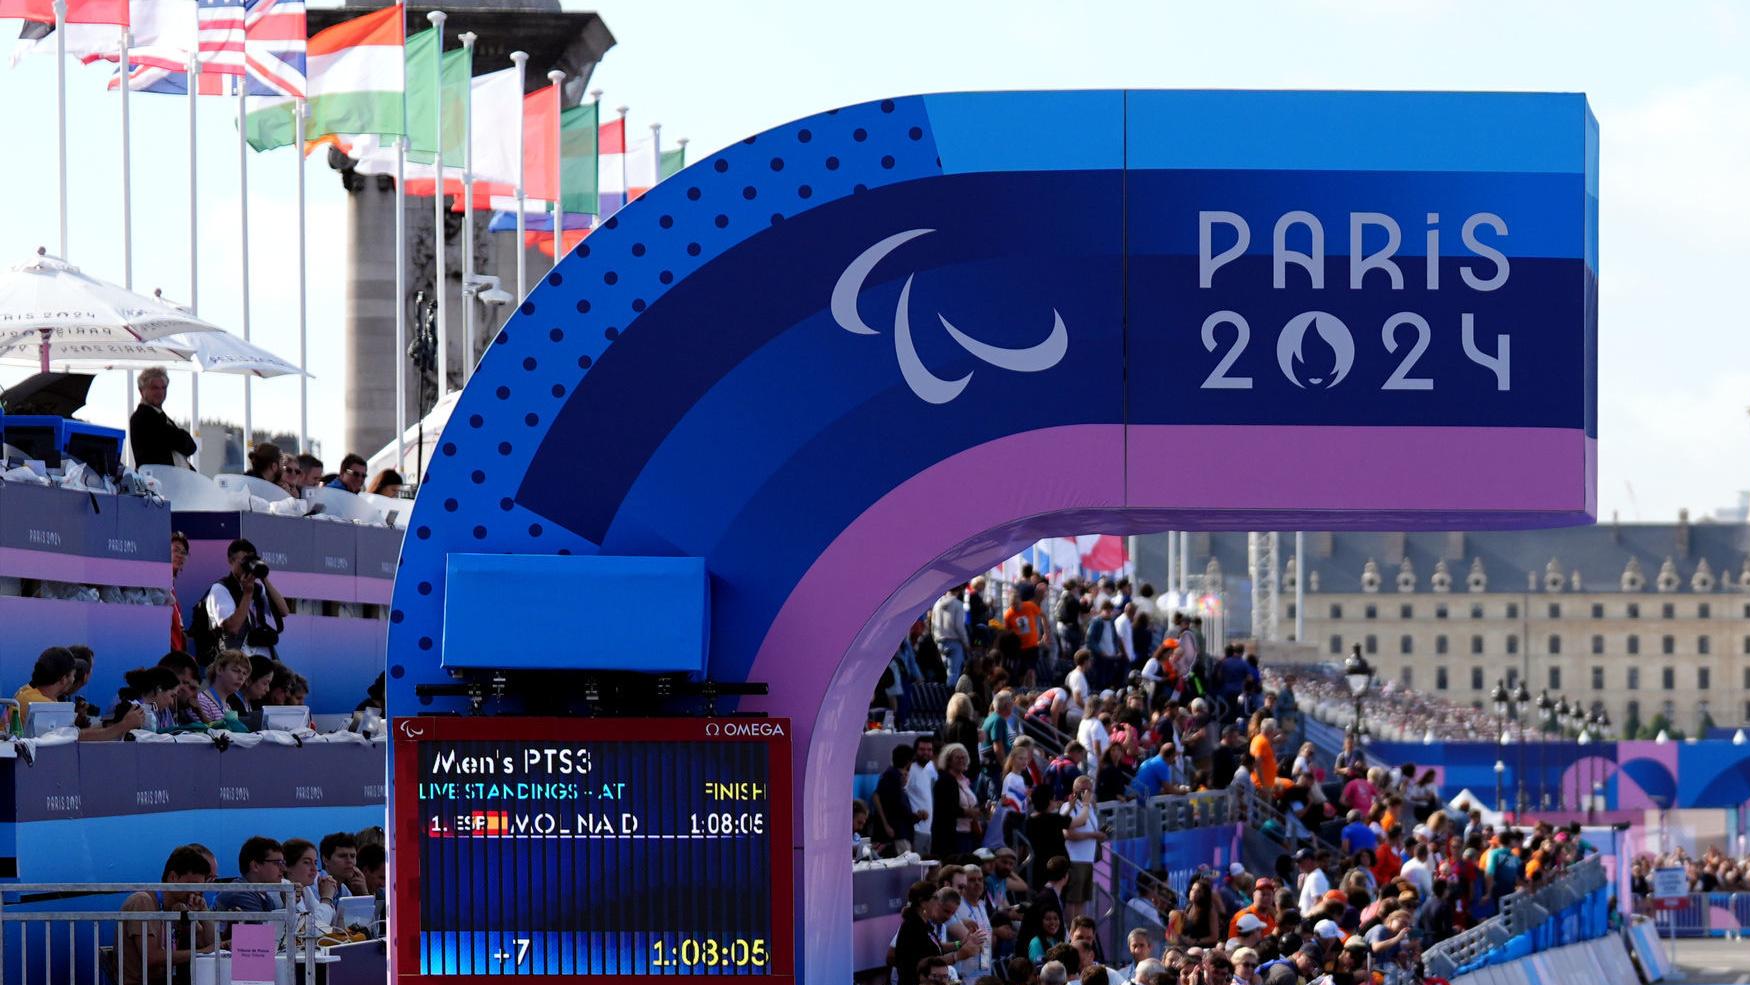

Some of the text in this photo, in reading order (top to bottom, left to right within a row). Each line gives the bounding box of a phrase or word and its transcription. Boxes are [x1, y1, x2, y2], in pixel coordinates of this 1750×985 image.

[1199, 310, 1511, 391] 2024
[724, 723, 784, 737] OMEGA
[432, 748, 592, 774] Men's PTS3
[419, 783, 459, 800] LIVE
[464, 783, 577, 800] STANDINGS
[598, 784, 626, 800] AT
[690, 812, 764, 835] 1:08:05
[493, 938, 770, 967] +7 1:08:05
